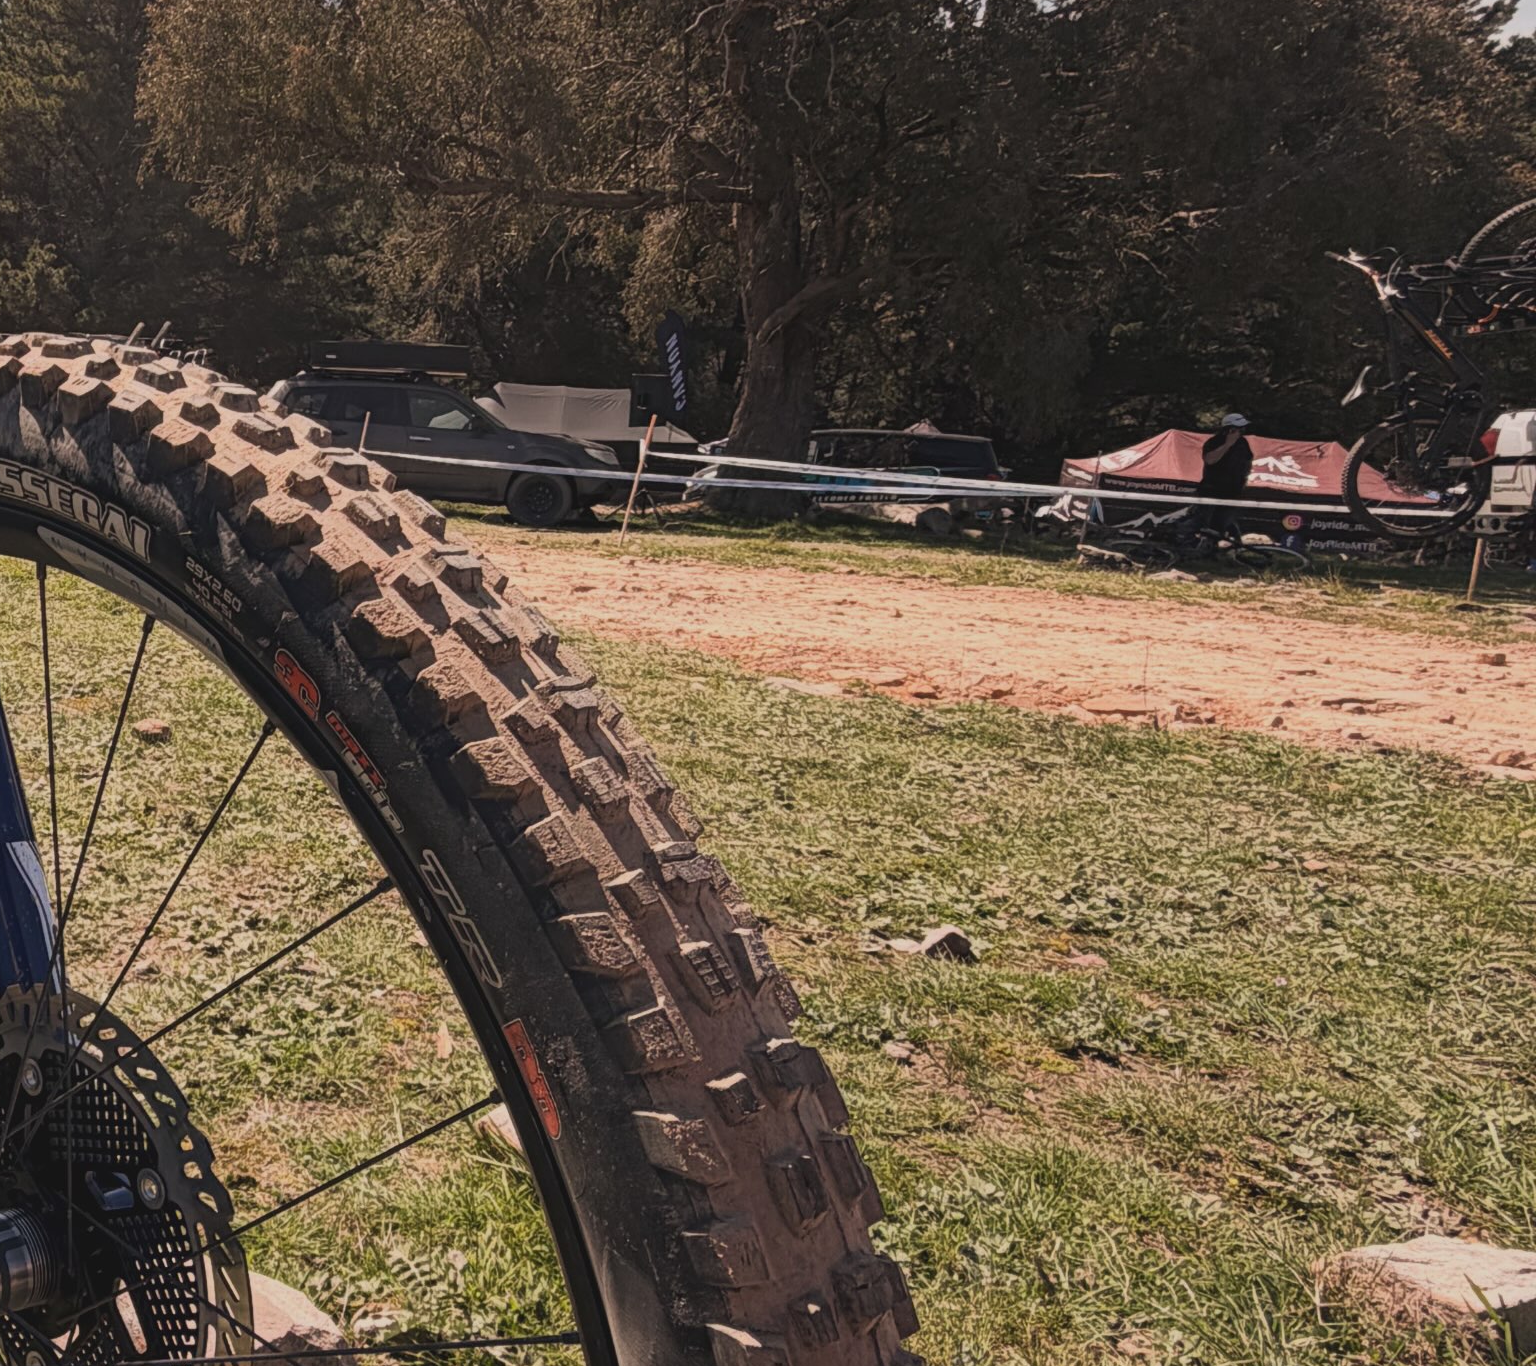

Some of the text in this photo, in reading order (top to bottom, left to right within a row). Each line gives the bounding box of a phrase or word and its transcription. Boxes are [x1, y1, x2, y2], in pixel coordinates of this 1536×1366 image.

[185, 556, 243, 613] 29X2.60
[192, 577, 232, 620] 40 PSI
